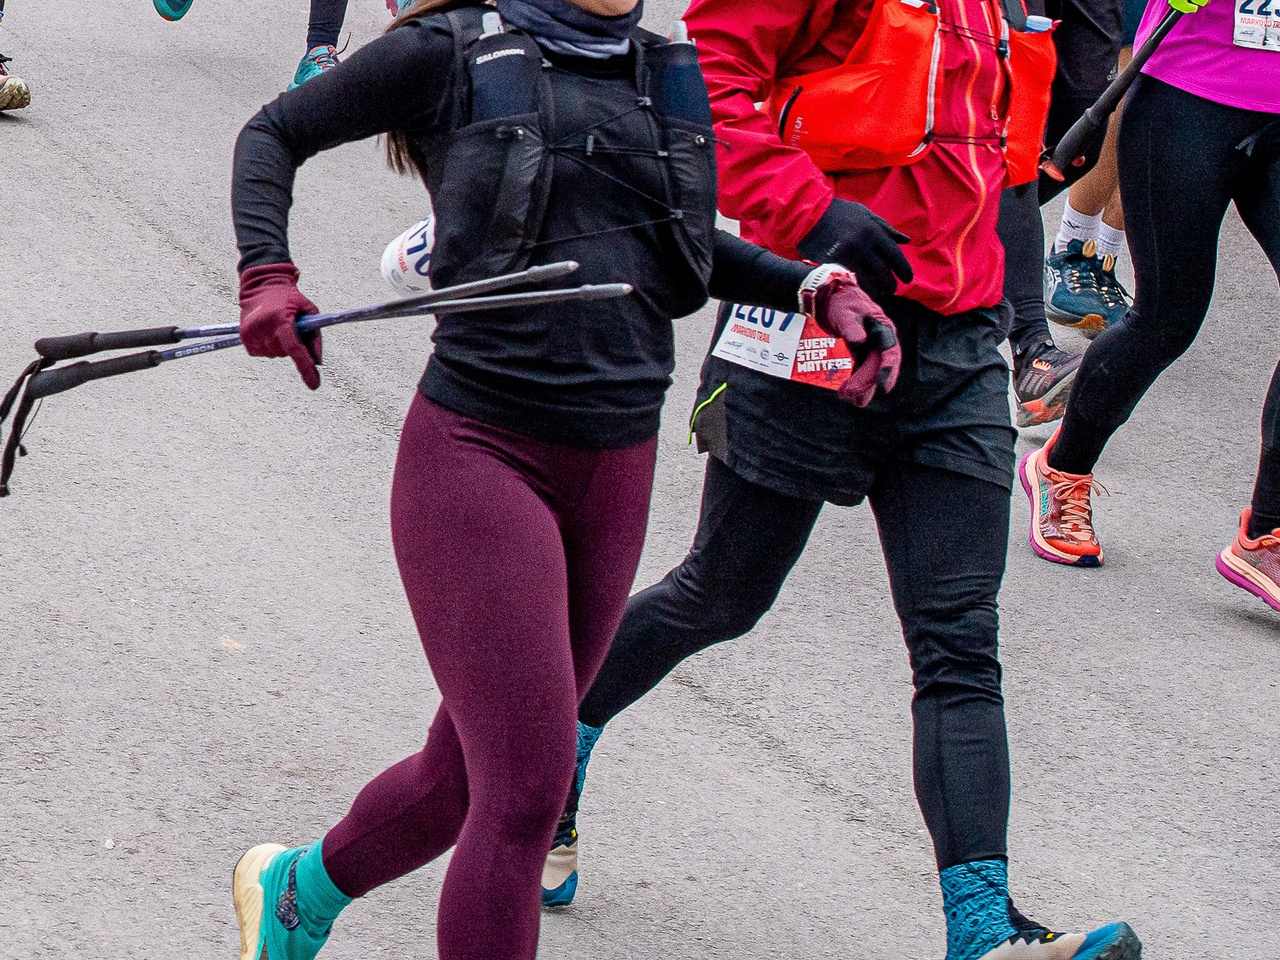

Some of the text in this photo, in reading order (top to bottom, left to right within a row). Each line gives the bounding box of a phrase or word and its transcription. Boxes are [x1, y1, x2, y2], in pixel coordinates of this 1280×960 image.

[475, 48, 525, 65] SALOMON
[797, 337, 836, 350] EVERY
[796, 348, 828, 361] STEP
[796, 357, 853, 373] MATTERS
